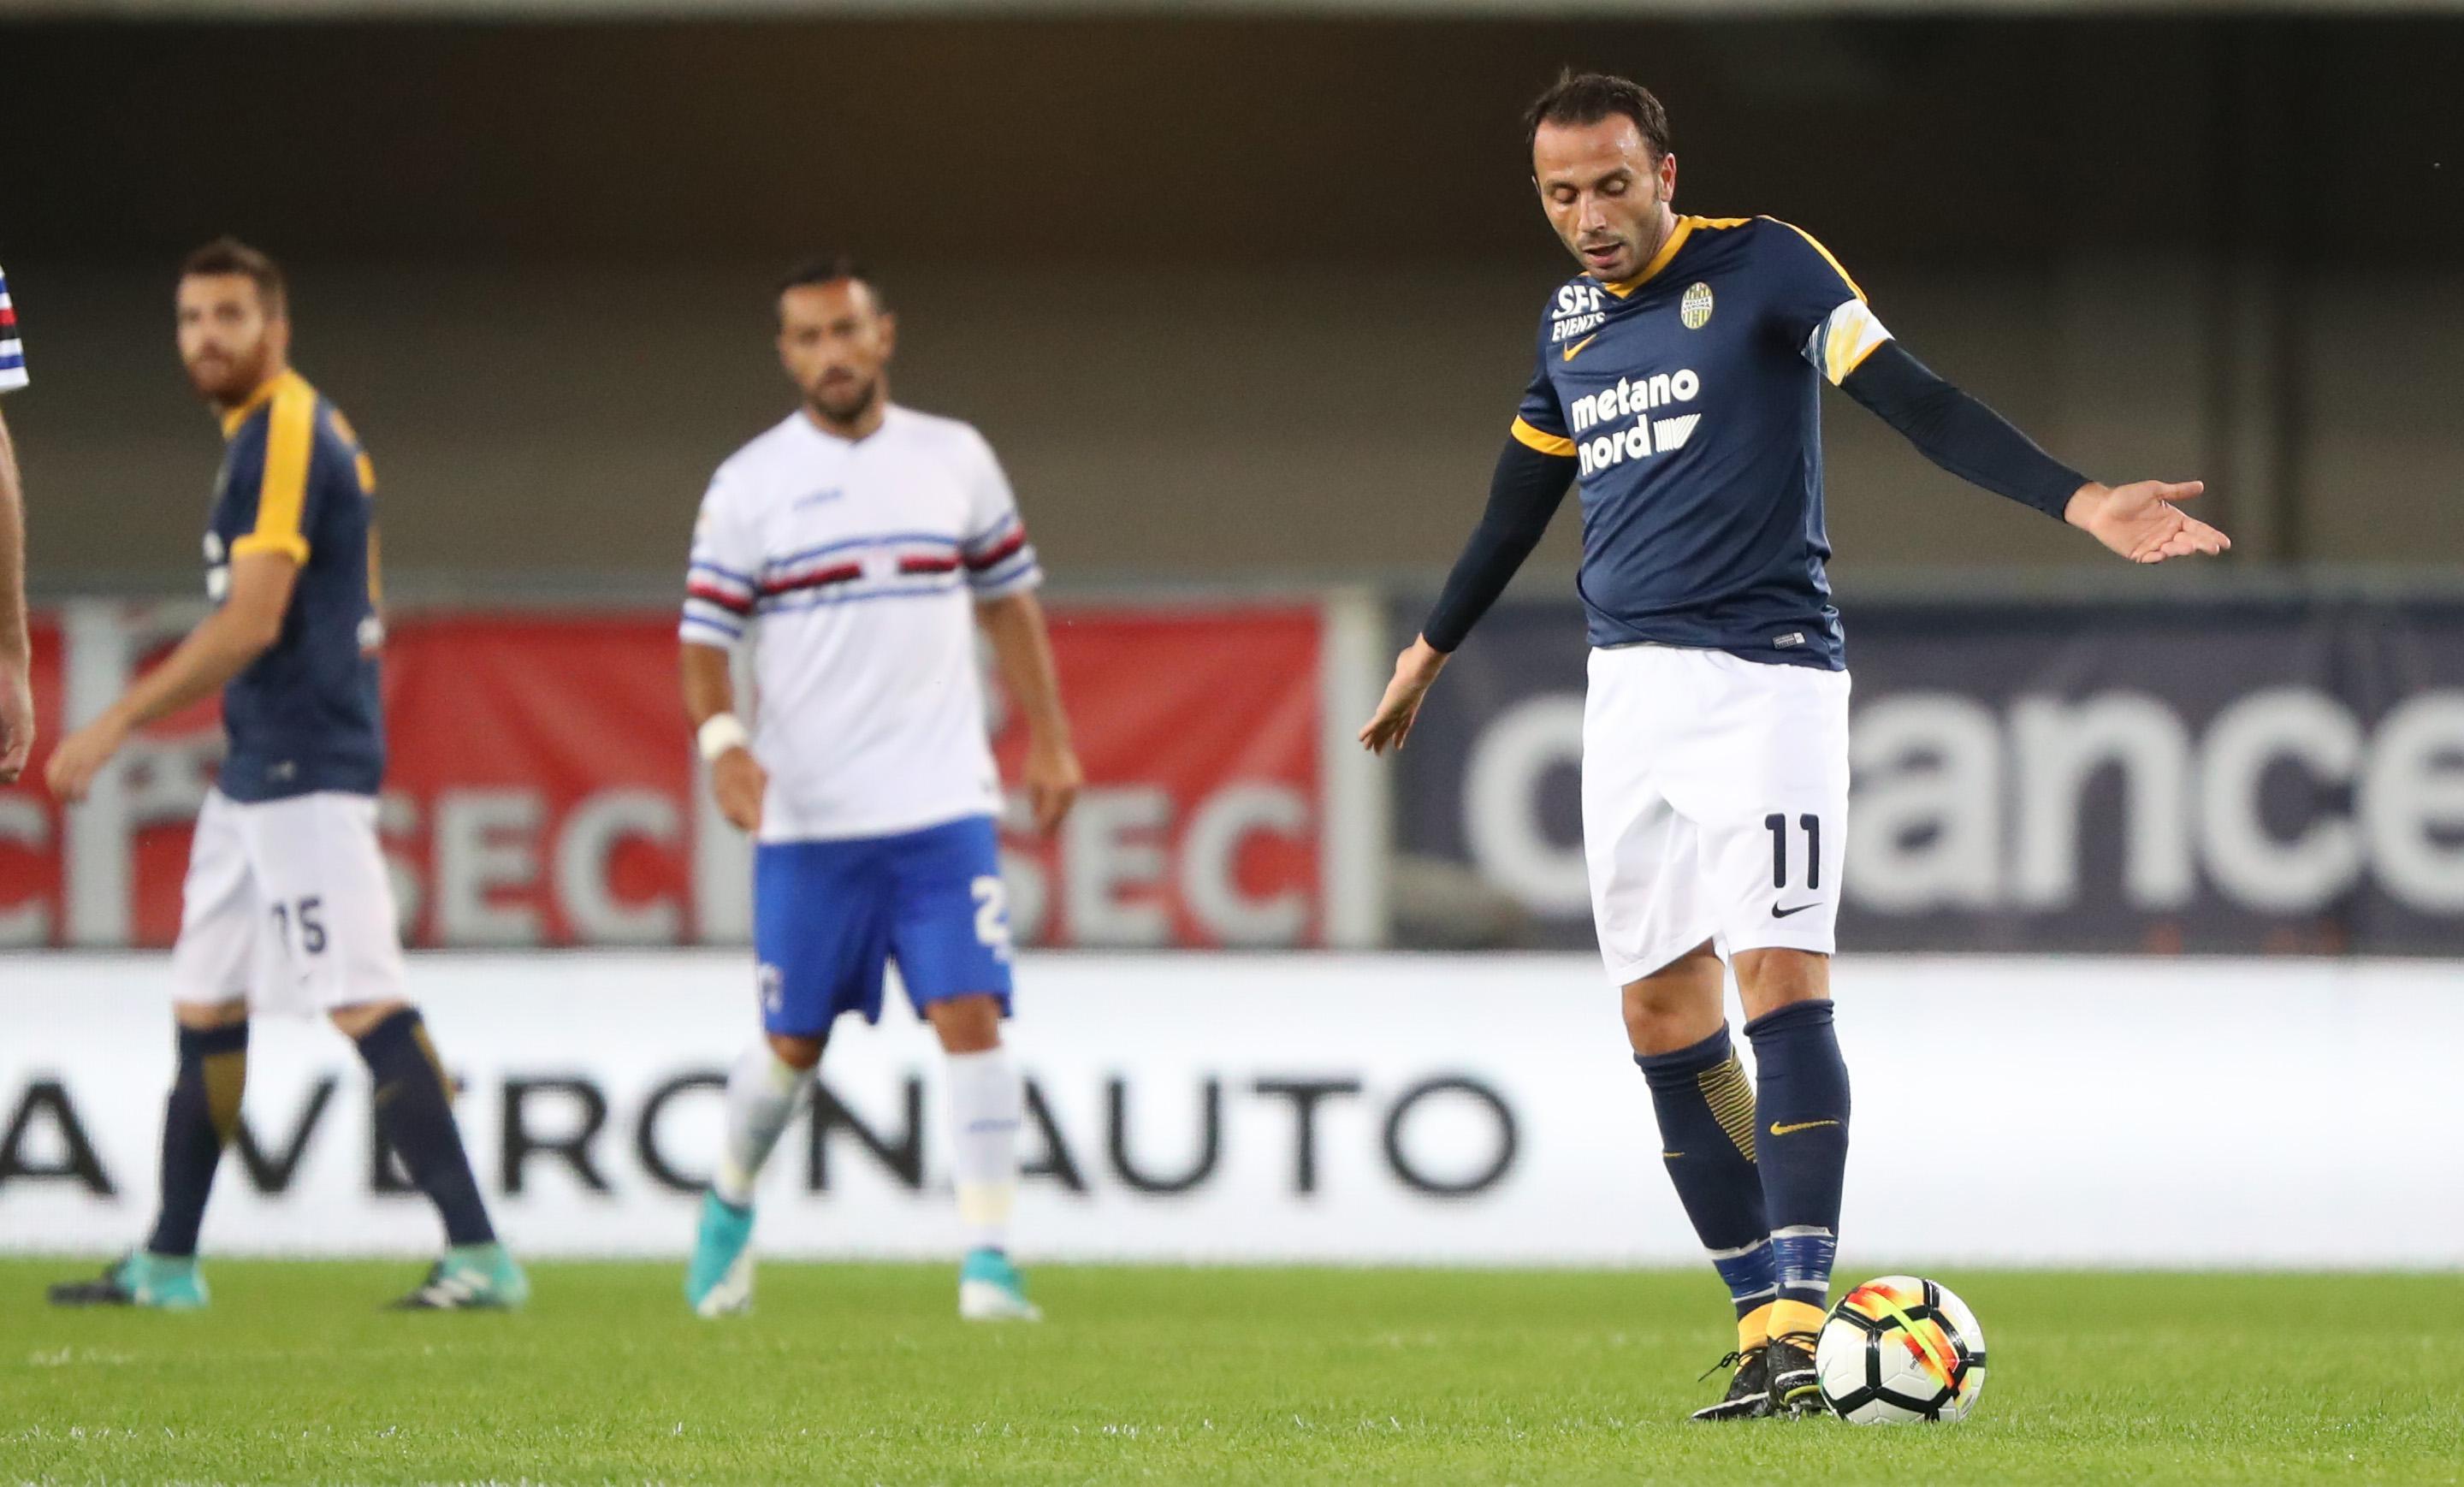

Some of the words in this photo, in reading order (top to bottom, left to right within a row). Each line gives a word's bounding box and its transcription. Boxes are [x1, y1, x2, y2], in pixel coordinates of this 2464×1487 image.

[1551, 311, 1606, 342] EVENTS
[1572, 369, 1699, 432] metano
[1578, 414, 1652, 476] nord
[1765, 813, 1820, 890] 11
[271, 895, 326, 956] 15
[234, 1076, 1519, 1196] VRONAUTO
